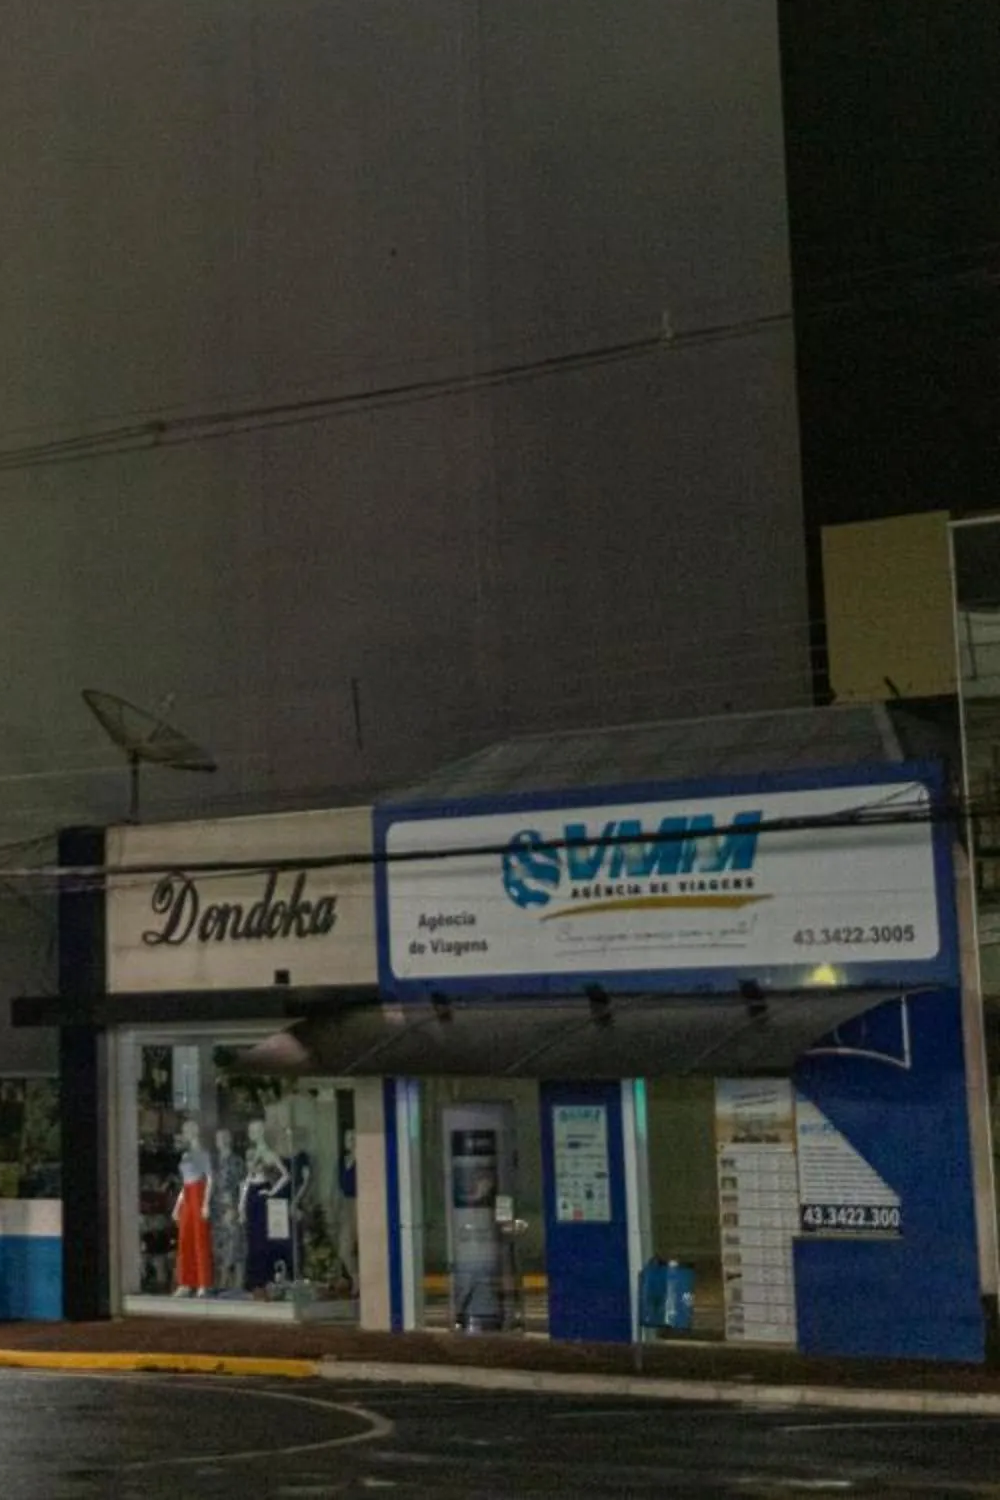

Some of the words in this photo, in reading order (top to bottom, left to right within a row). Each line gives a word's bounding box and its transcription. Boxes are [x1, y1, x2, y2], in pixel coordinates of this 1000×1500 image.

[649, 883, 670, 894] DE
[679, 876, 756, 893] VIAGENS
[141, 867, 338, 946] Dondoka
[793, 924, 916, 945] 43.3422.3005
[430, 938, 489, 956] Viagens
